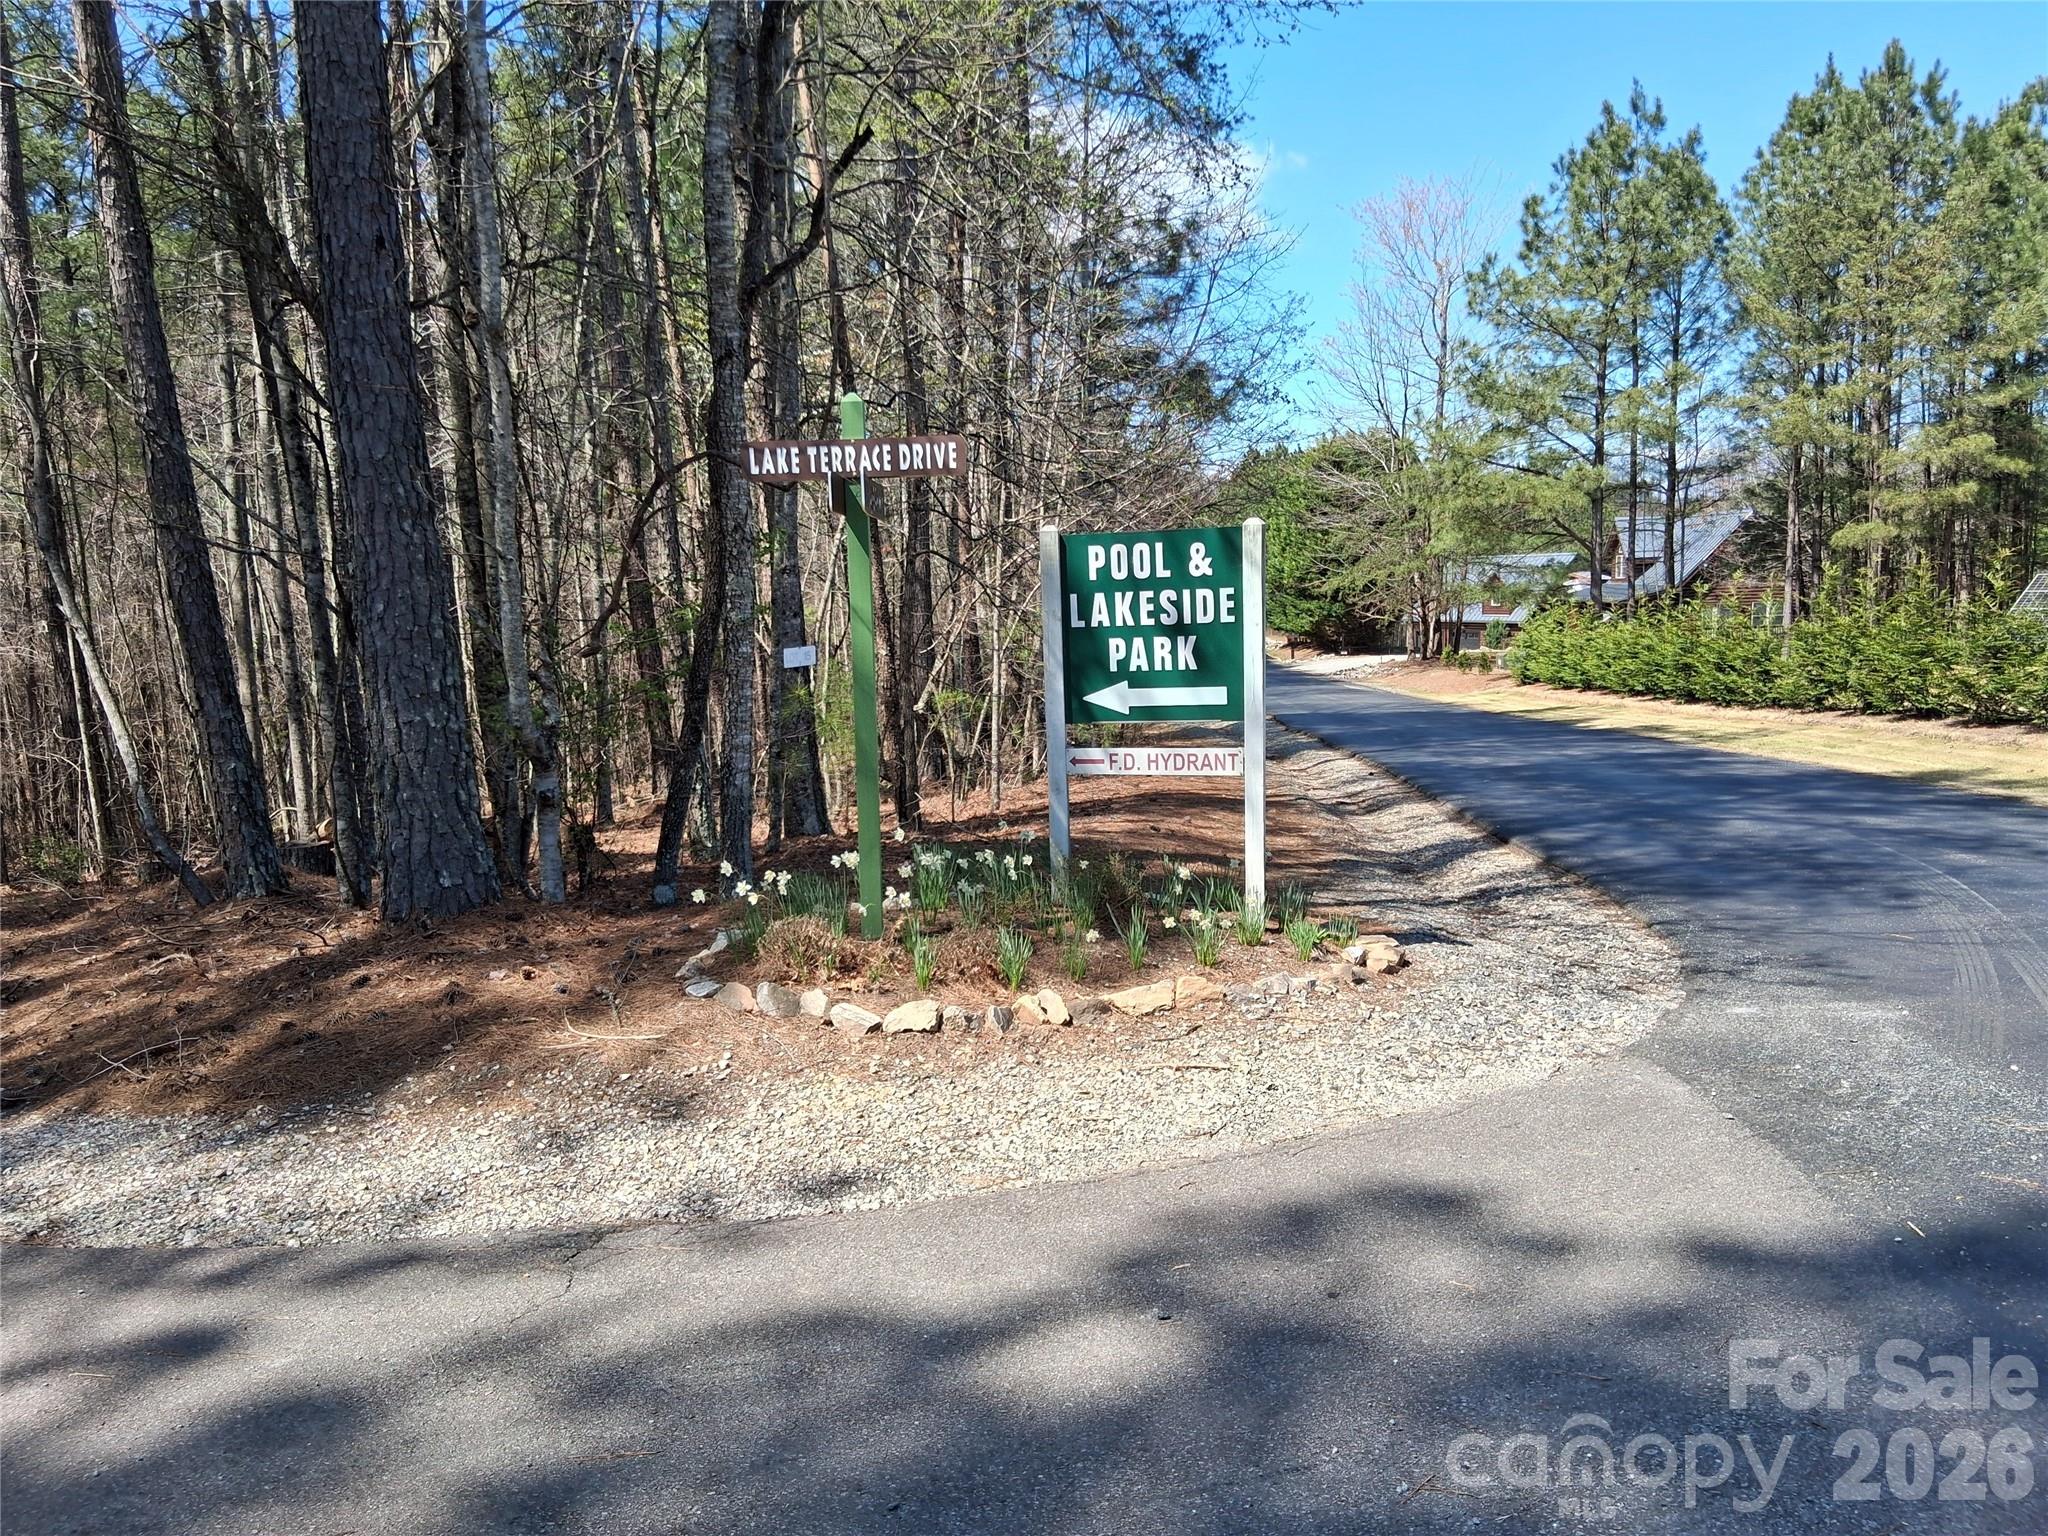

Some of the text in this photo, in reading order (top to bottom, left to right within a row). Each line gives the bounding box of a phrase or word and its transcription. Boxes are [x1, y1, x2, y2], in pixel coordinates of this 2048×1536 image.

[749, 442, 957, 475] LAKE TERRACE DRIVE
[1087, 542, 1213, 581] POOL &
[1069, 587, 1236, 628] LAKESIDE
[1108, 635, 1198, 672] PARK
[1108, 753, 1239, 771] F.D. HYDRANT
